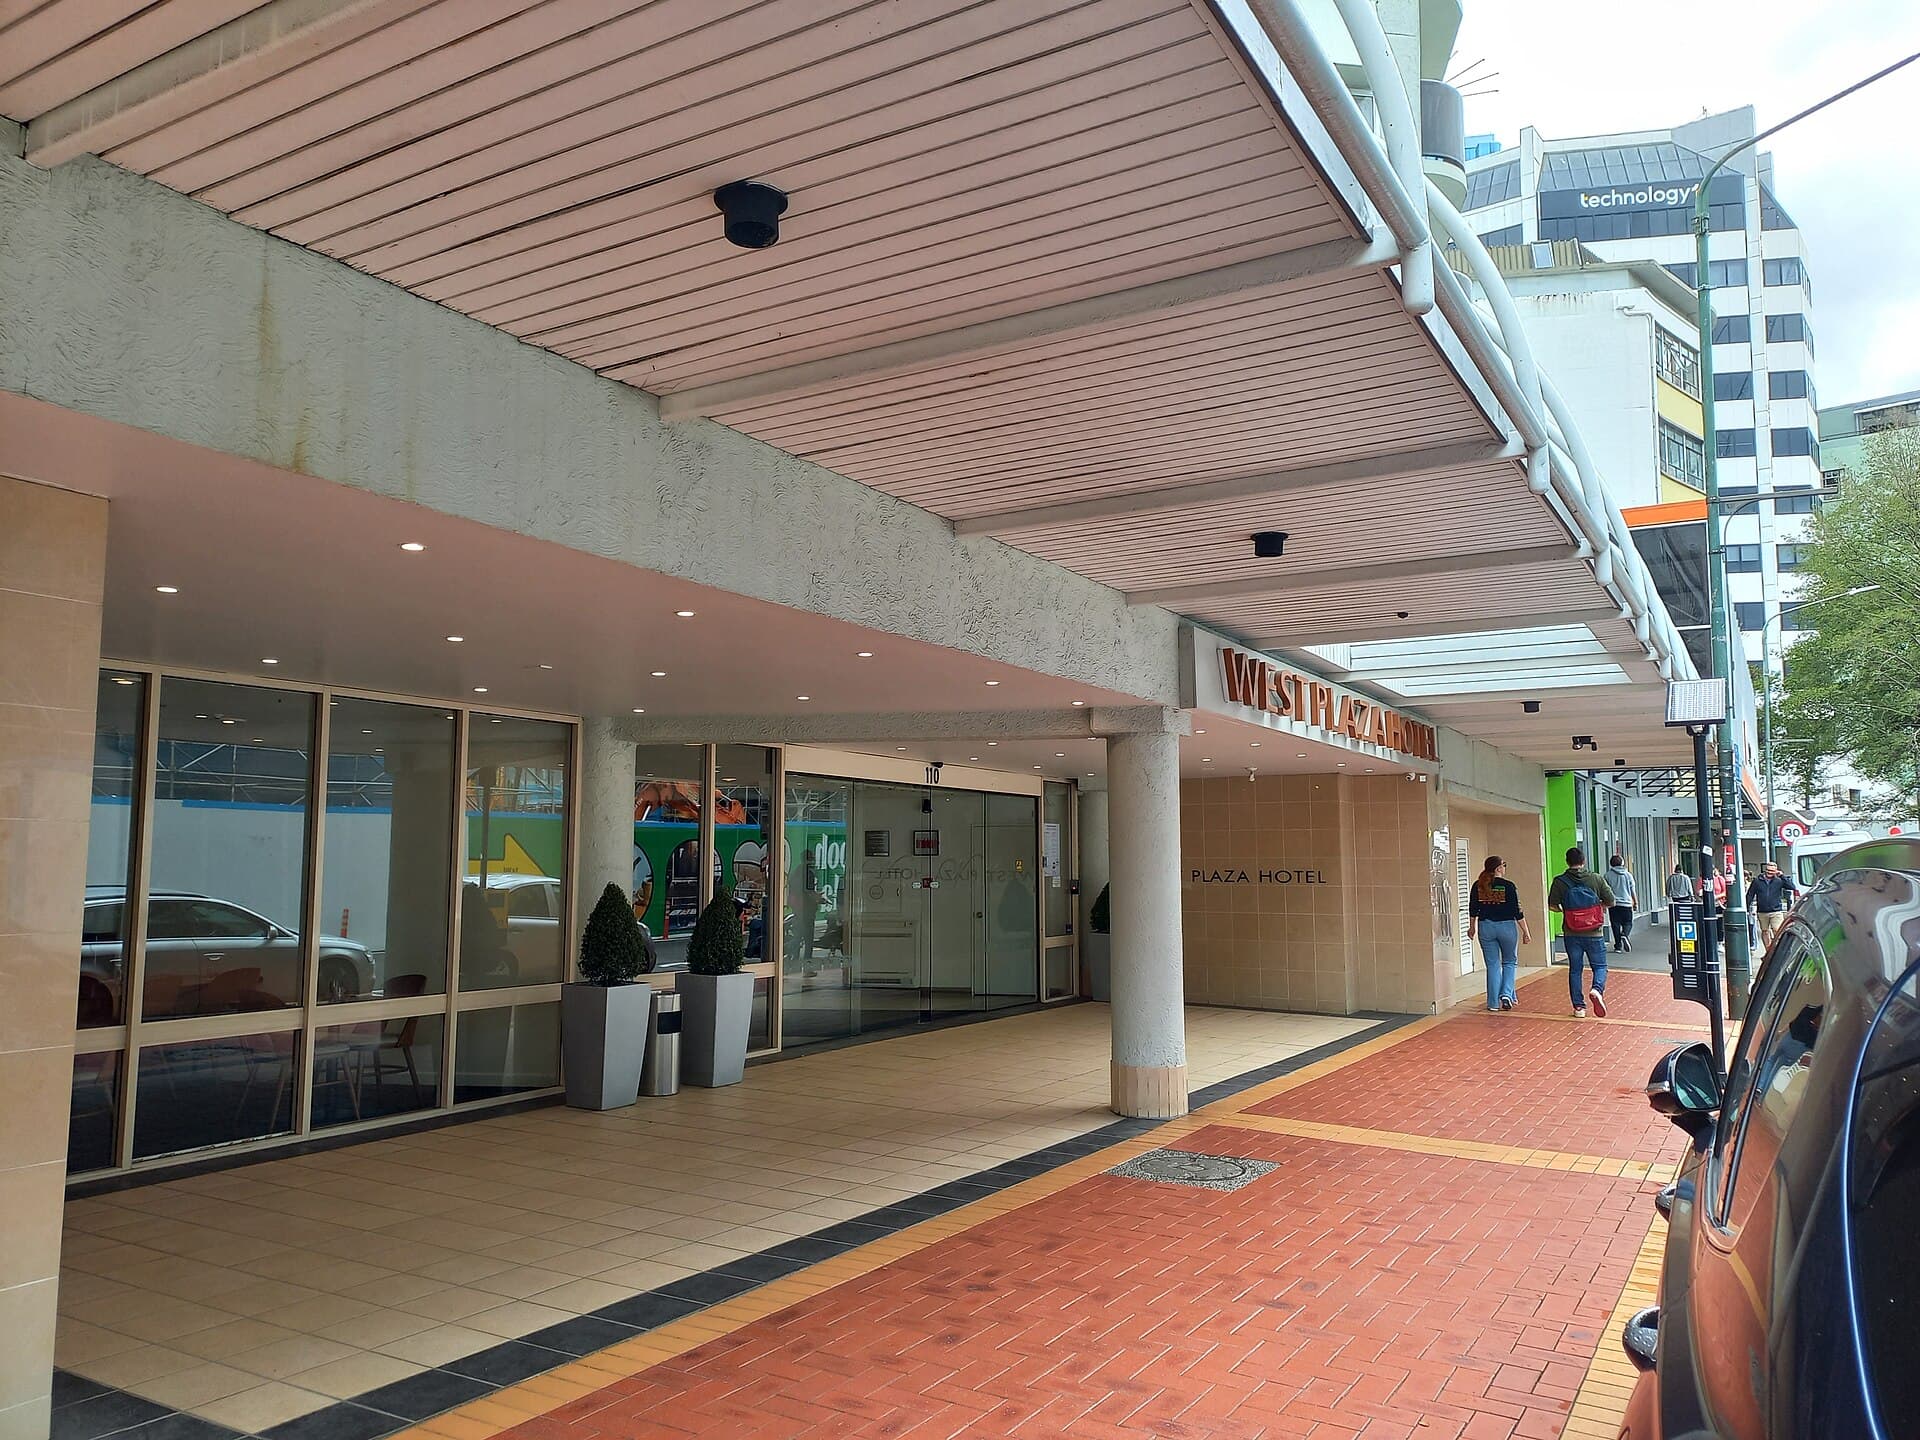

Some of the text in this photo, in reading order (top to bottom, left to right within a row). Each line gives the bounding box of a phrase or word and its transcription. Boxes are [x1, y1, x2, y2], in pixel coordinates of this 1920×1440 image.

[1221, 648, 1440, 762] WEST PLAZA HOTEL
[926, 767, 939, 784] 110
[1785, 828, 1800, 838] 30
[1191, 870, 1326, 884] PLAZA HOTEL
[1682, 924, 1693, 938] P
